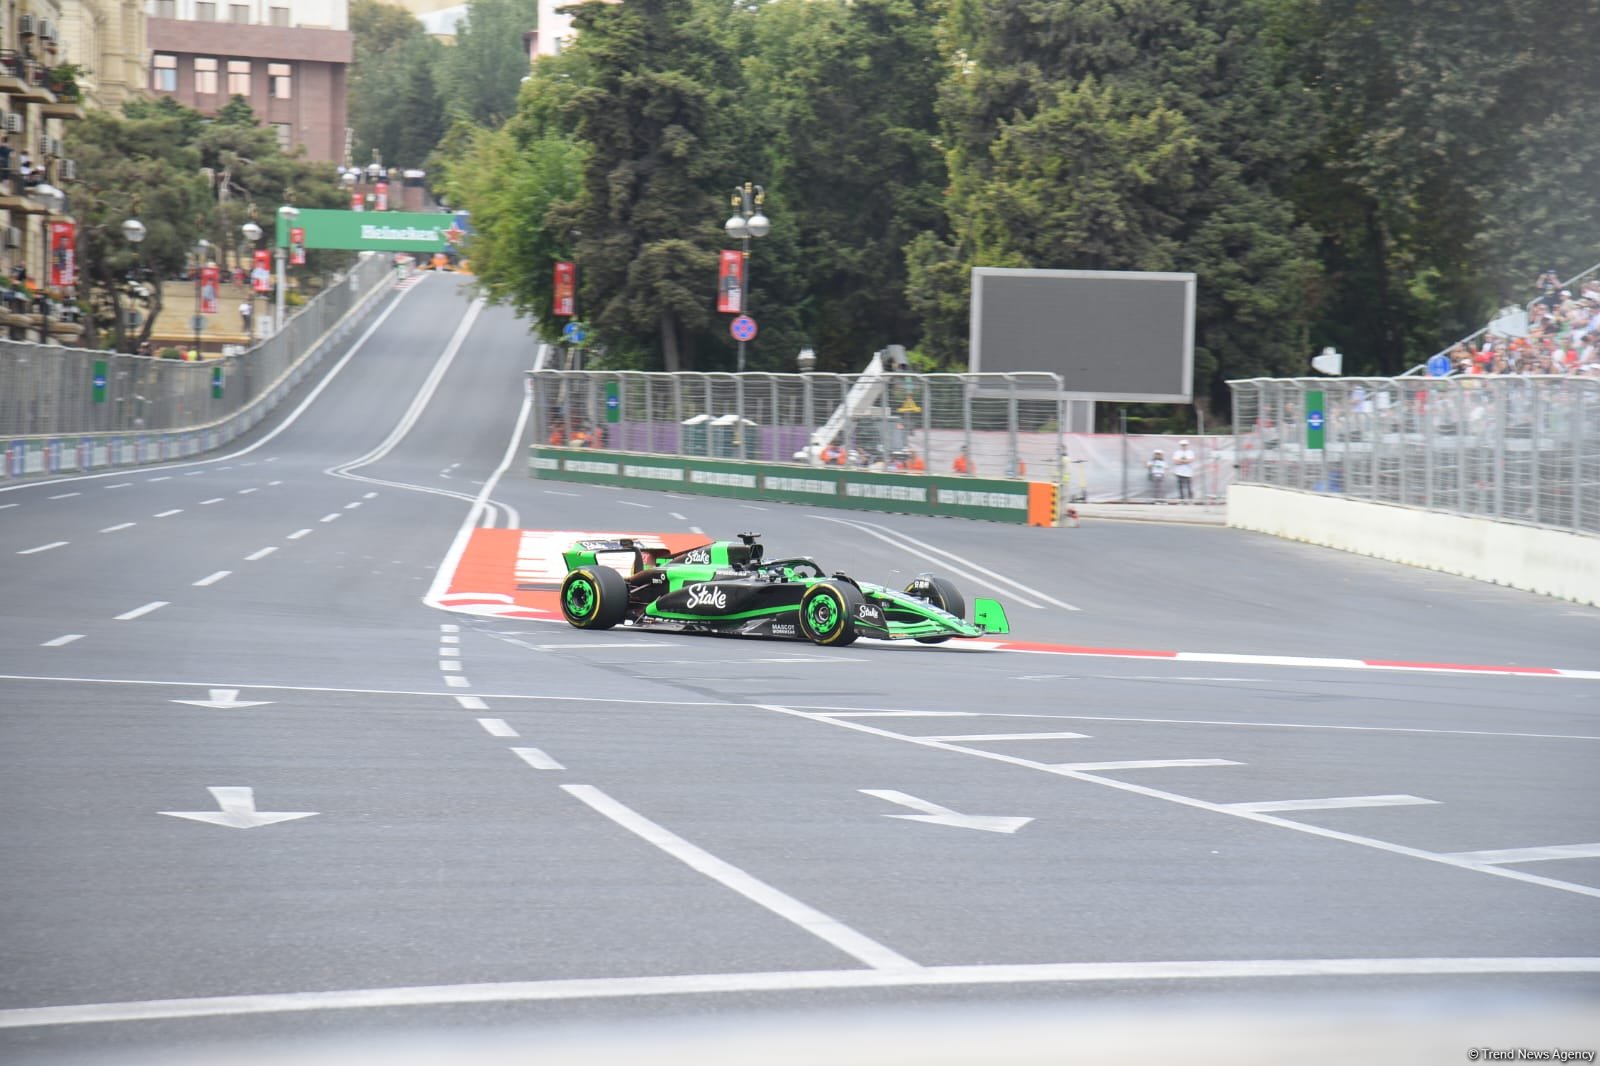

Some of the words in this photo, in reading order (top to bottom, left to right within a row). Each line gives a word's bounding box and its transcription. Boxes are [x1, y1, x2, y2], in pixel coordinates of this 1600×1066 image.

[685, 550, 710, 565] Stake
[686, 583, 727, 609] Stake
[860, 604, 879, 619] Stake
